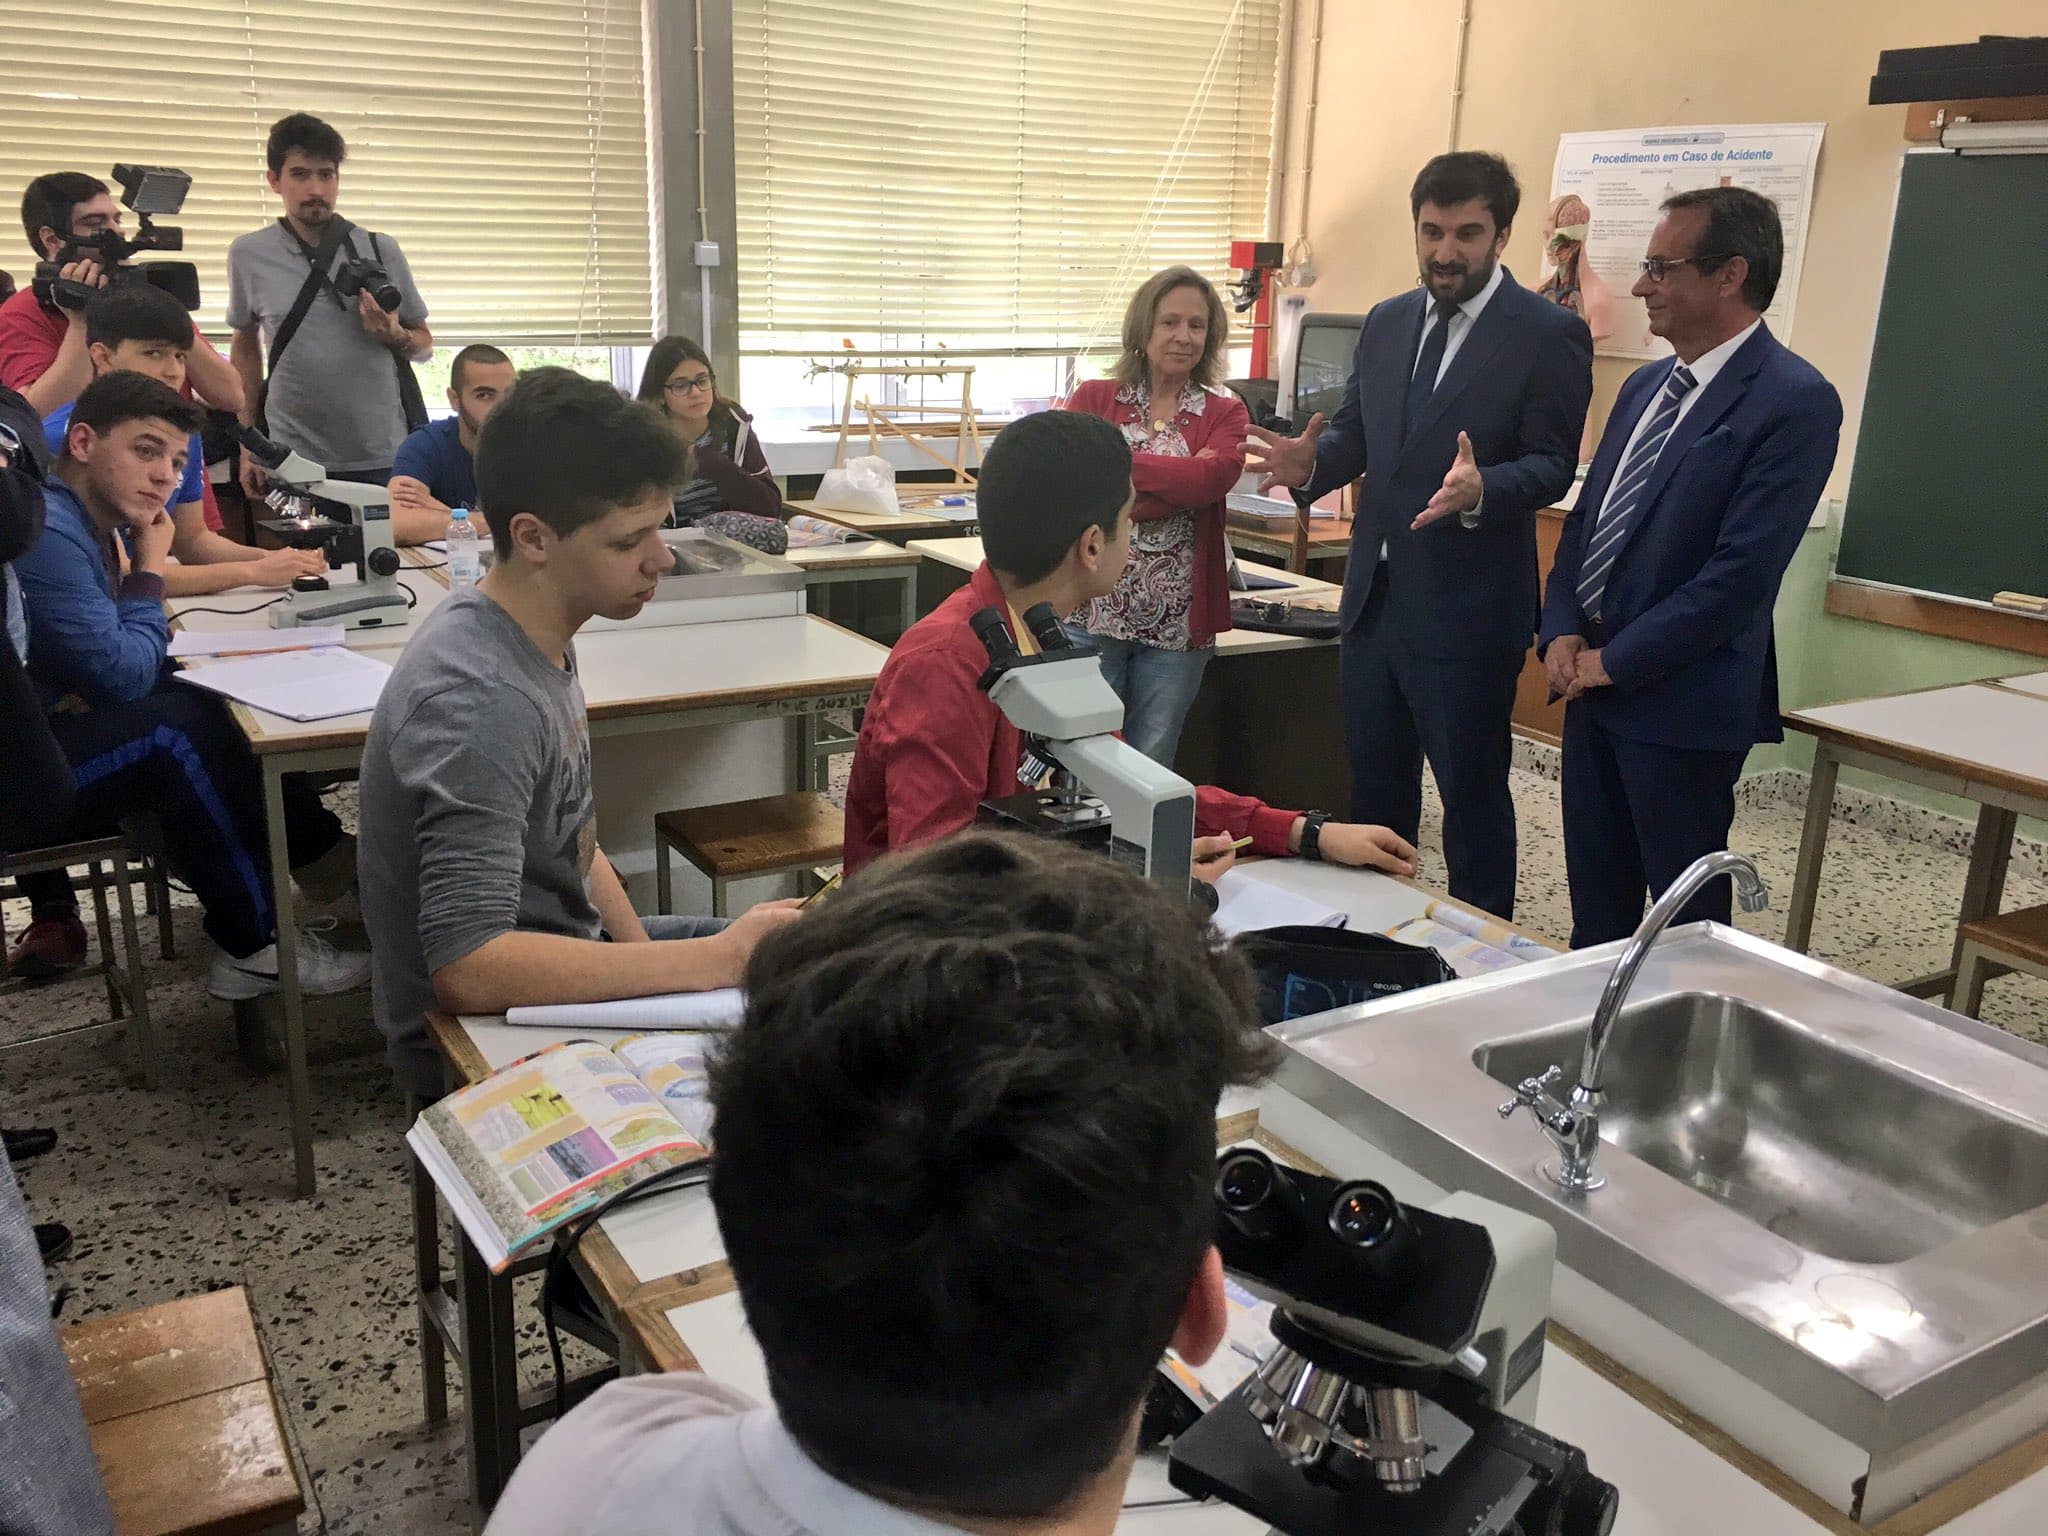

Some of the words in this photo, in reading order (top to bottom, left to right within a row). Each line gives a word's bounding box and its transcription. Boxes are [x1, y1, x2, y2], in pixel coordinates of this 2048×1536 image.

[1592, 152, 1660, 164] Procedimento
[1662, 153, 1678, 162] em
[1682, 150, 1708, 161] Caso
[1711, 150, 1724, 161] de
[1726, 149, 1773, 160] Acidente
